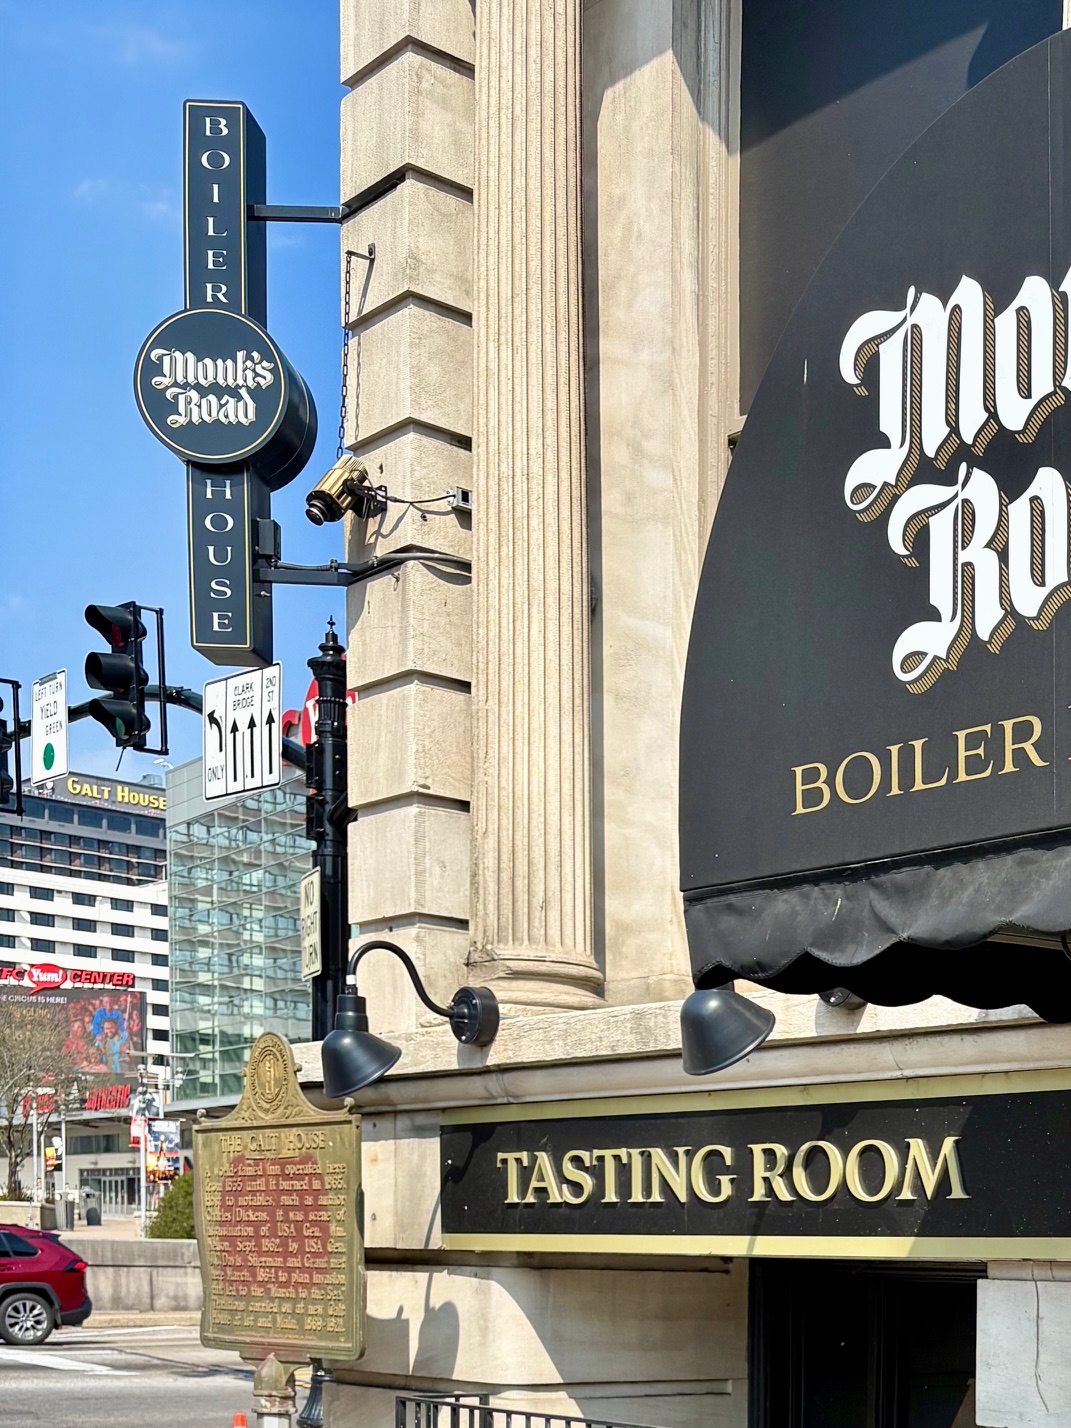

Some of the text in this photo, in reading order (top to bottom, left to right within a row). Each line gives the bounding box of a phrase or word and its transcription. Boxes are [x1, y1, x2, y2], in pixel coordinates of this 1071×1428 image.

[200, 116, 231, 303] BOILER
[150, 348, 275, 390] Monk's
[165, 386, 257, 428] Road
[204, 479, 234, 632] HOUSE
[234, 681, 255, 697] CLARK
[265, 675, 277, 689] 2ND
[35, 681, 63, 702] LEFT TURN
[267, 690, 275, 703] ST
[40, 700, 58, 720] YIELD
[232, 695, 255, 711] BRIDGE
[45, 720, 63, 736] GREEN
[207, 764, 225, 783] ONLY
[790, 714, 1050, 817] BOILER
[67, 777, 167, 810] GALT HOUSE
[304, 880, 315, 909] NO
[0, 967, 135, 986] FC Yum! CENTER
[220, 1131, 326, 1153] THE GALT HOUSE
[267, 1163, 281, 1176] inn
[285, 1161, 322, 1178] operated
[496, 1136, 972, 1205] TASTING ROOM
[246, 1178, 266, 1192] until
[279, 1177, 309, 1191] burned
[226, 1195, 234, 1207] to
[280, 1193, 300, 1206] such
[304, 1195, 314, 1206] as
[260, 1224, 270, 1237] of
[278, 1222, 296, 1237] USA
[303, 1223, 322, 1237] Gen.
[289, 1239, 300, 1255] by
[305, 1239, 323, 1253] USA
[327, 1239, 346, 1253] Gen.
[248, 1252, 284, 1267] Sherman
[286, 1255, 302, 1268] and
[305, 1254, 328, 1269] Grant
[257, 1266, 275, 1282] 1864
[278, 1270, 287, 1283] to
[291, 1270, 310, 1286] plan
[313, 1271, 346, 1285] invasion
[250, 1284, 265, 1297] the
[249, 1300, 279, 1313] carried
[281, 1303, 292, 1314] on
[257, 1314, 272, 1328] and
